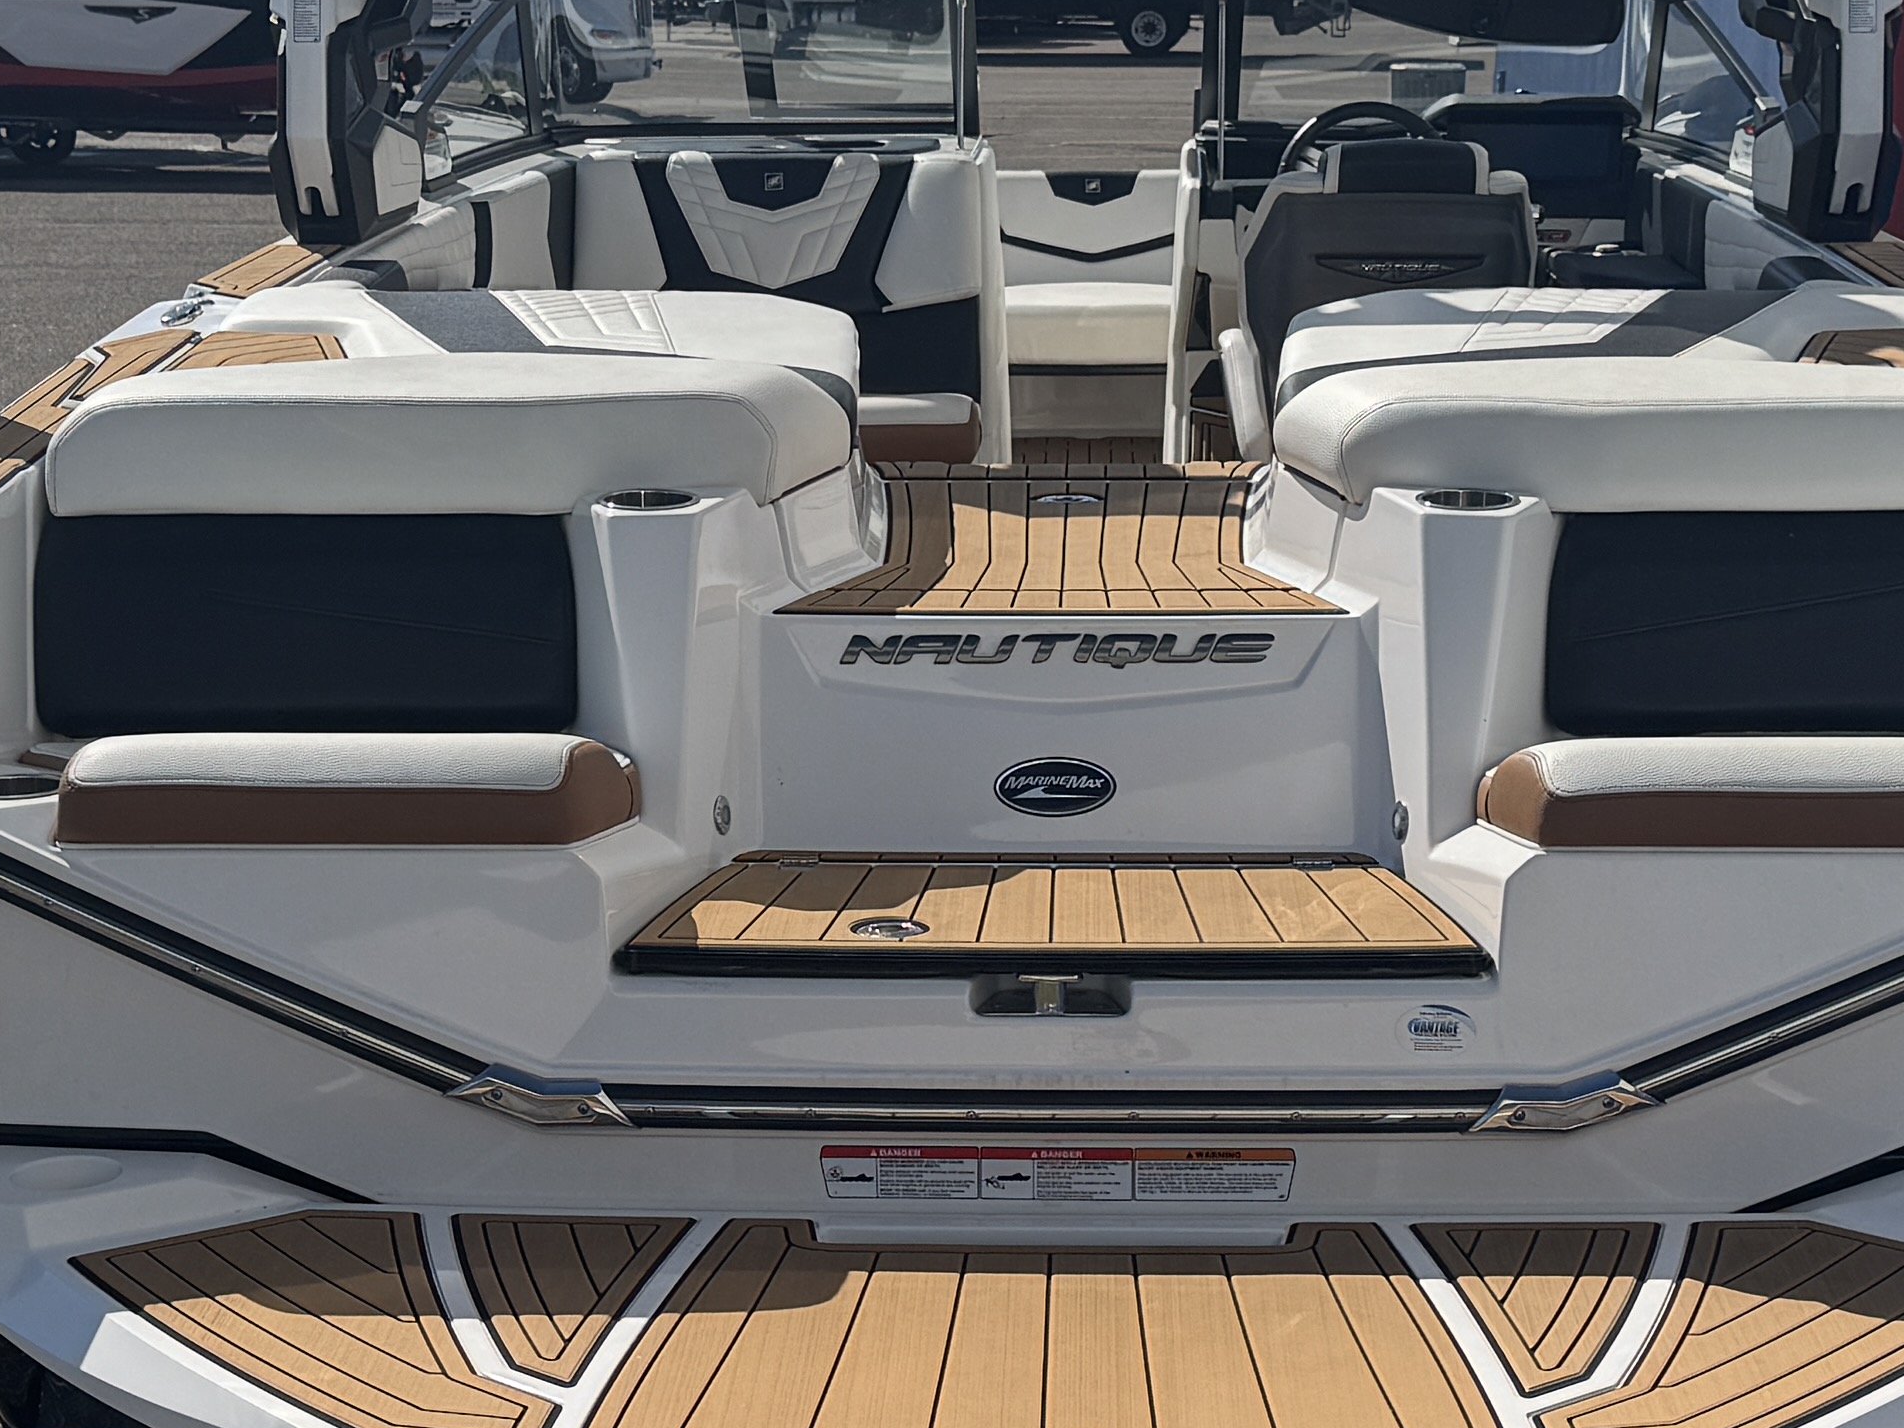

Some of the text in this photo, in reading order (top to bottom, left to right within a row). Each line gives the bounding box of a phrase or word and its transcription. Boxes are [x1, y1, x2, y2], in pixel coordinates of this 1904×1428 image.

[839, 633, 1276, 670] NAUTIQUE
[879, 1148, 921, 1157] DANGER
[1040, 1150, 1083, 1159] DANGER
[1196, 1151, 1242, 1159] WARNING
